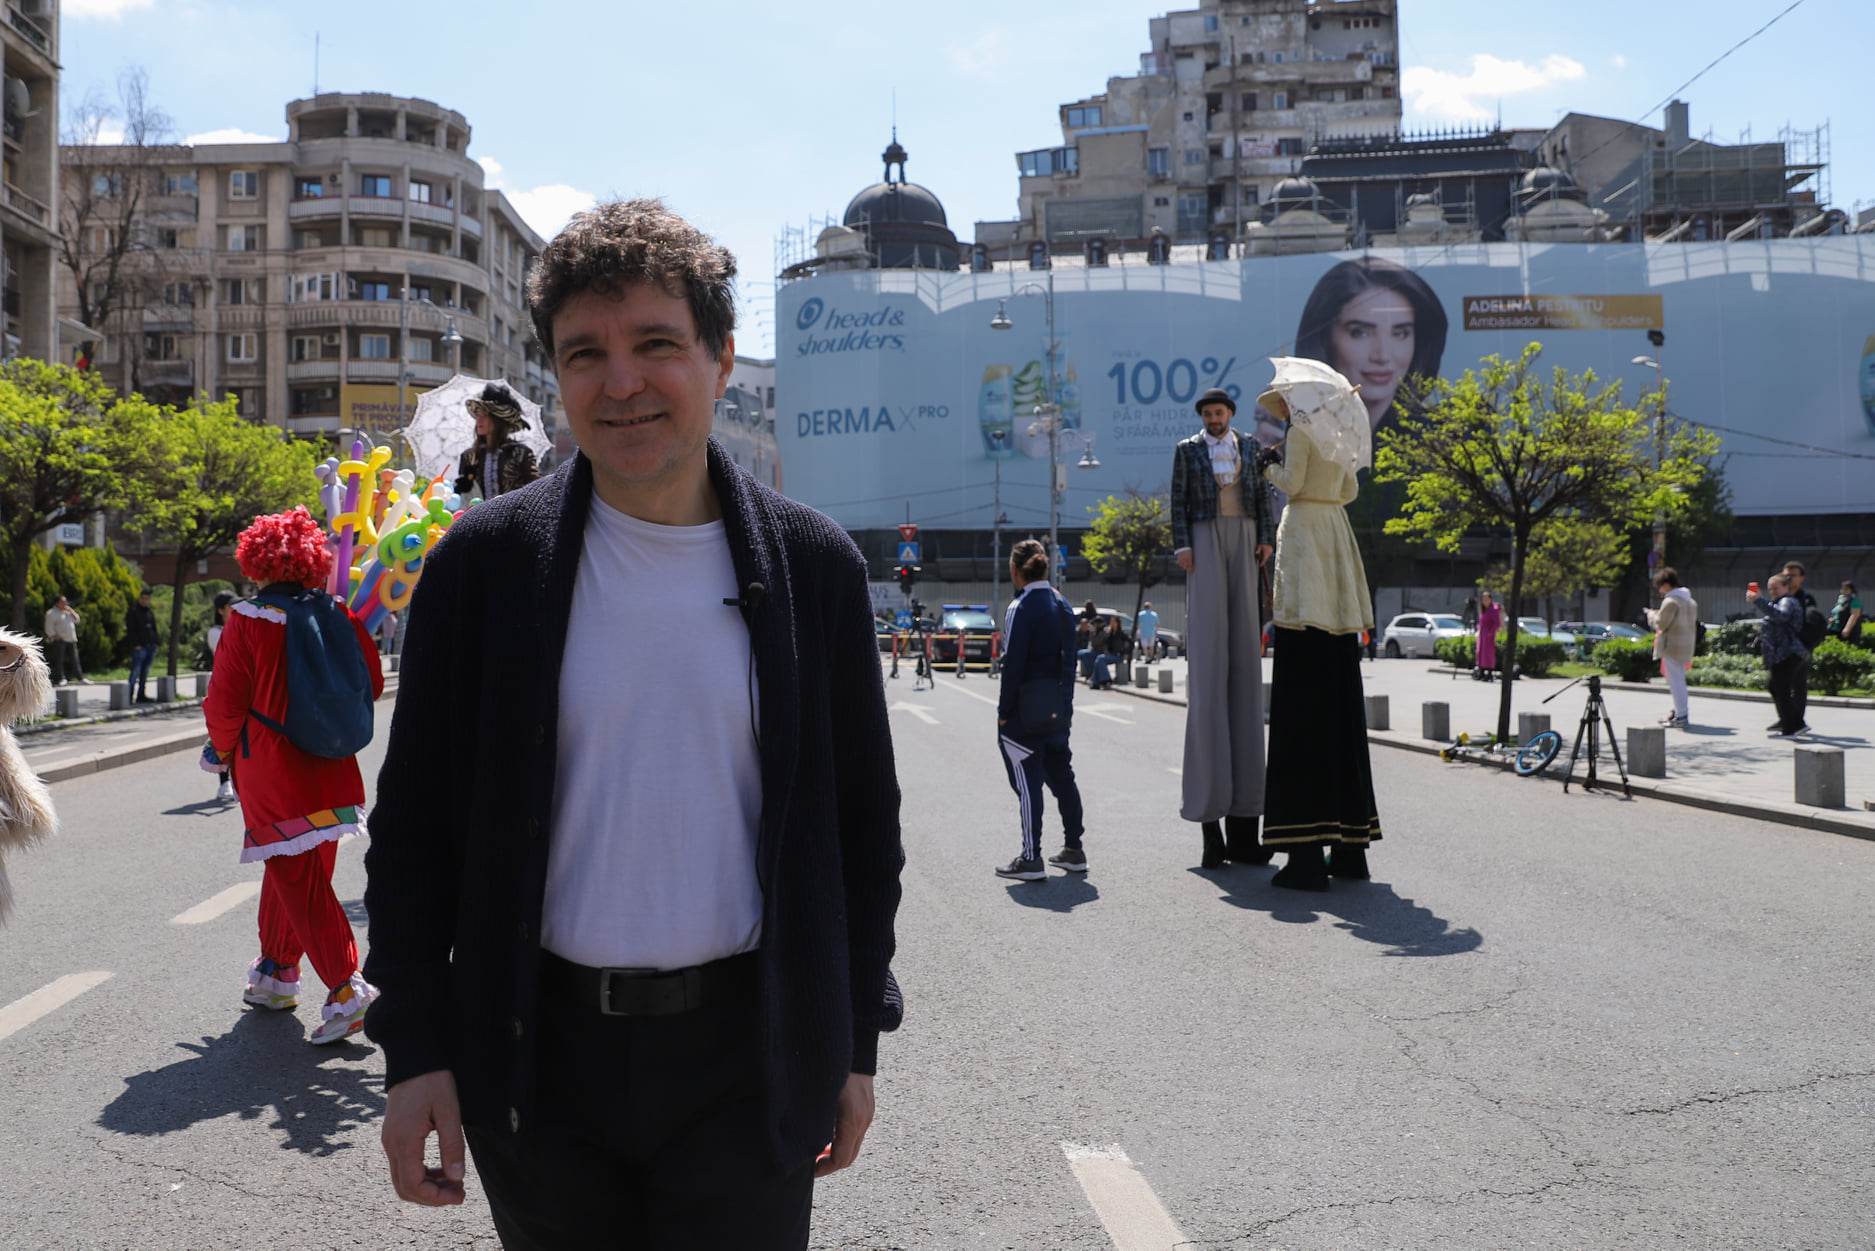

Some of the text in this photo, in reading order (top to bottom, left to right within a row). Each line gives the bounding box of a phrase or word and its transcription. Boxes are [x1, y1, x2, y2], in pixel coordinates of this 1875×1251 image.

[825, 306, 905, 331] head &
[1468, 299, 1534, 313] ADELINA
[796, 330, 905, 358] shoulders
[1107, 356, 1242, 405] 100%
